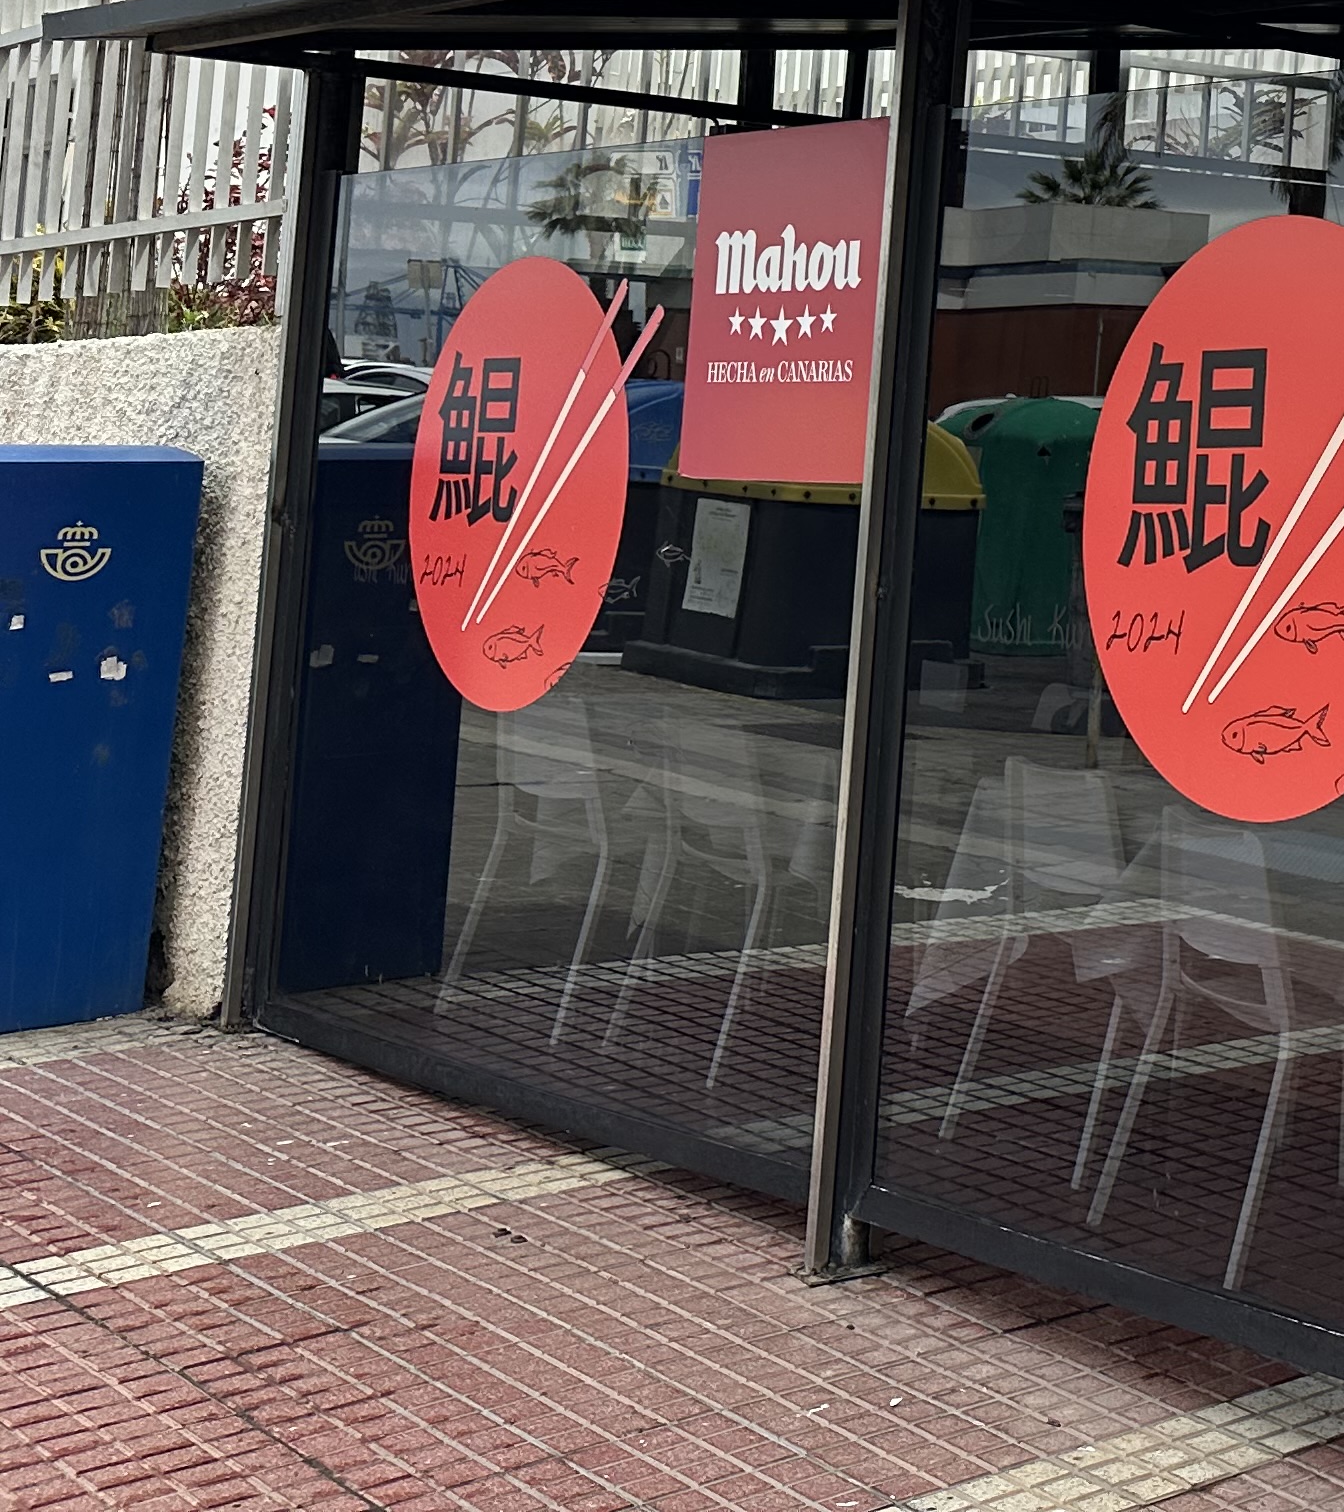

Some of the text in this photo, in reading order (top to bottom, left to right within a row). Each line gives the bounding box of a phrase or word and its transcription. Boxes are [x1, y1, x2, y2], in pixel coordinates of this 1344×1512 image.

[715, 223, 862, 295] Mahou
[706, 359, 854, 384] HECHA en CANARIAS
[420, 554, 467, 588] 2024
[1105, 608, 1187, 655] 2024
